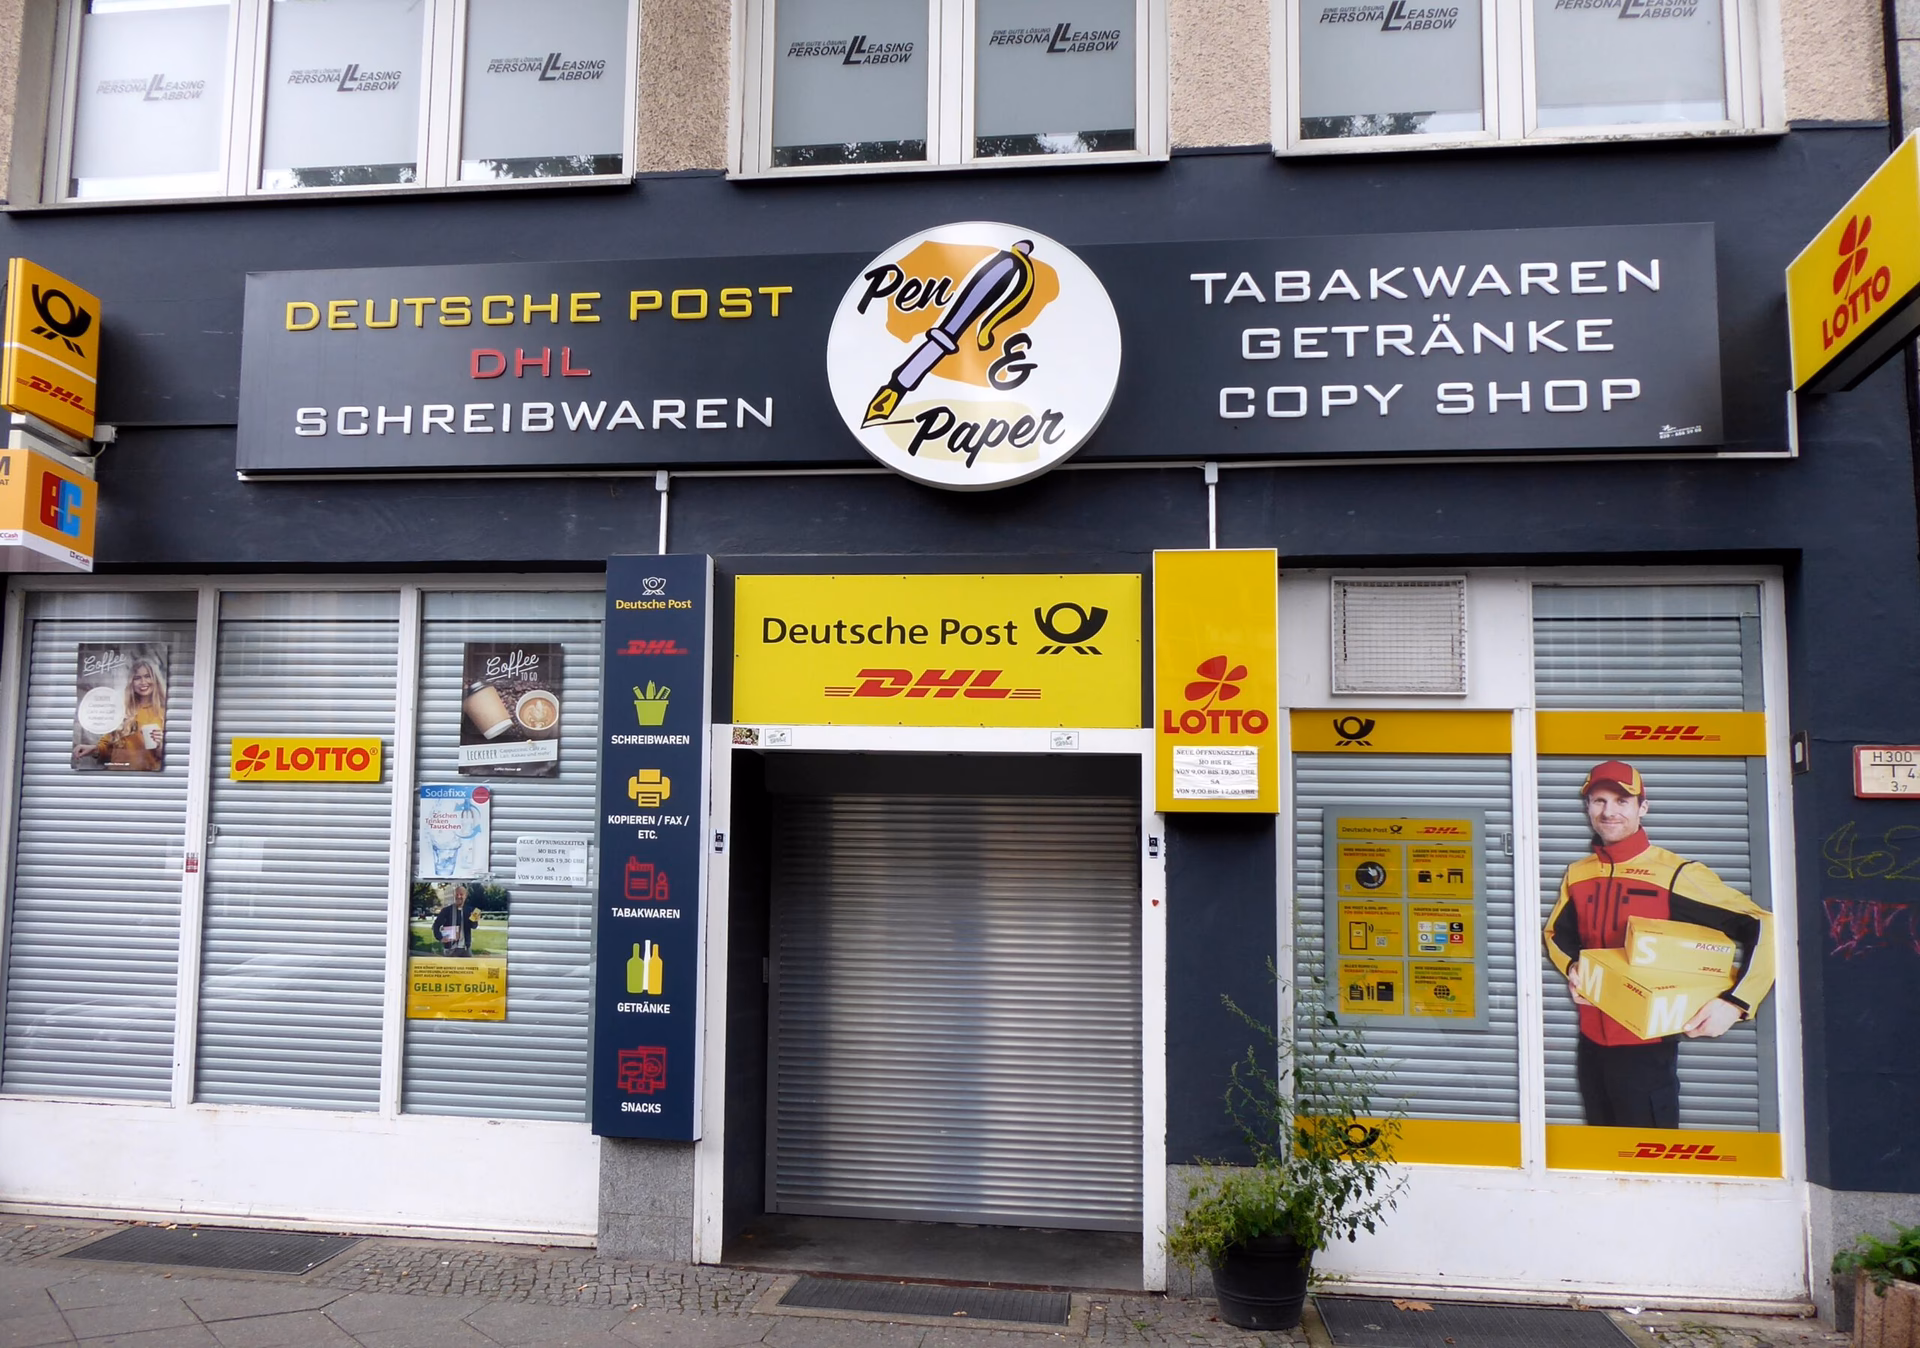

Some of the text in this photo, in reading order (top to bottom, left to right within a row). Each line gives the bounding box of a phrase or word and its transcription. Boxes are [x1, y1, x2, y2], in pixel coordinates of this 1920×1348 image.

[857, 263, 956, 315] Pen
[1190, 258, 1660, 304] TABAKWAREN
[285, 286, 793, 331] DEUTSCHE POST
[1822, 265, 1891, 351] LOTTO
[1241, 313, 1615, 360] GETRÄNKE
[470, 346, 592, 379] DHL
[988, 332, 1038, 391] &
[28, 375, 87, 412] DHL
[1219, 378, 1641, 419] COPY SHOP
[294, 397, 774, 436] SCHREIBWAREN
[907, 406, 1065, 469] Paper
[615, 599, 692, 610] Deutsche Post
[762, 616, 1018, 646] Deutsche Post
[627, 640, 678, 655] DHL
[84, 649, 128, 674] Coffee
[486, 649, 541, 678] Coffee
[530, 671, 538, 681] GO
[852, 668, 1012, 699] DHL
[1163, 709, 1270, 734] LOTTO
[1619, 725, 1705, 741] DHL
[611, 734, 690, 745] SCHREIBWAREN
[467, 749, 499, 761] LECKERER
[425, 788, 467, 798] Sodafixx
[608, 815, 690, 827] KOPIEREN / FAX /
[1423, 826, 1460, 834] DHL
[638, 830, 658, 840] ETC.
[1624, 868, 1651, 876] DHL
[611, 907, 681, 919] TABAKWAREN
[1635, 936, 1657, 965] S
[1695, 943, 1731, 953] PACKSET
[414, 981, 499, 994] GELB IST GRÜN.
[1579, 957, 1604, 1003] M
[1625, 982, 1644, 997] DHL
[617, 1001, 671, 1014] GETRÄNKE
[1646, 994, 1688, 1037] M
[621, 1102, 662, 1114] SNACKS
[1633, 1143, 1721, 1162] DHL
